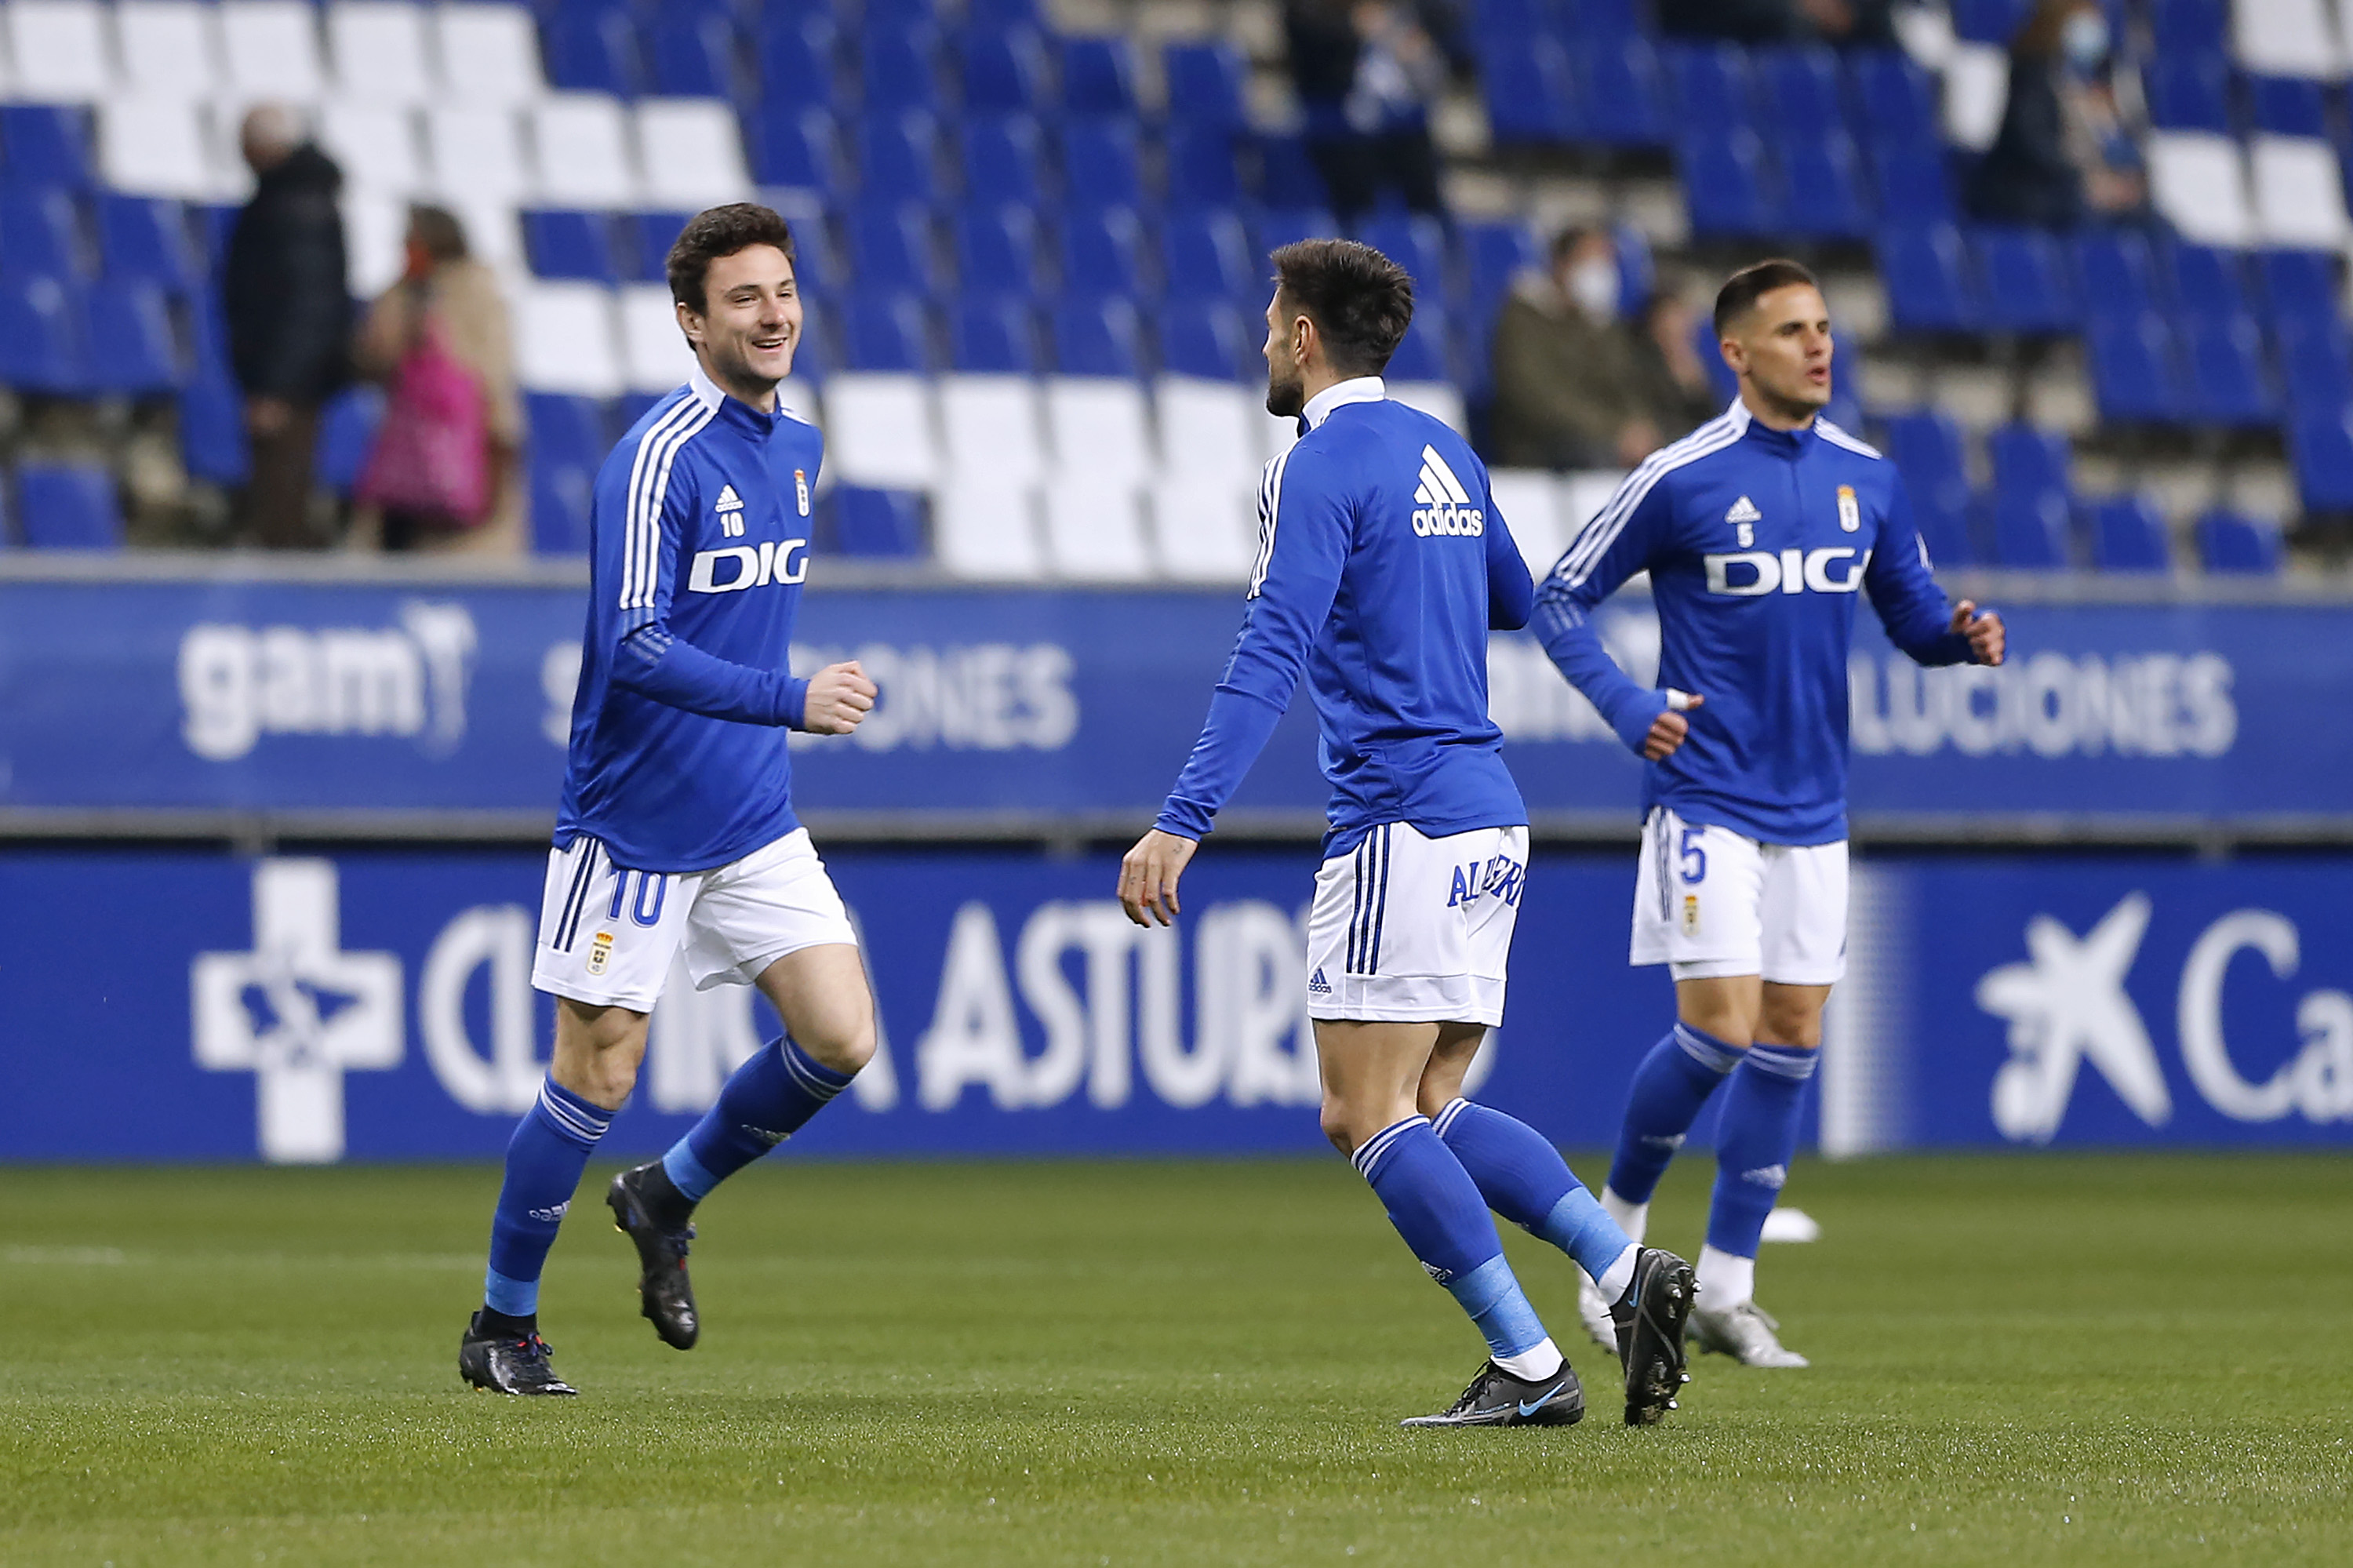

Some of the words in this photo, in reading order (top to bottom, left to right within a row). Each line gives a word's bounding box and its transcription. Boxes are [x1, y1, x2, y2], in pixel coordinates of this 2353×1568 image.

[720, 512, 745, 538] 10
[1412, 502, 1484, 537] adidas
[1737, 523, 1755, 548] 5
[179, 623, 425, 761] gam
[1848, 646, 2236, 755] LUCIONES
[1681, 828, 1706, 884] 5
[606, 869, 667, 928] 10
[916, 900, 1497, 1112] ASTUR
